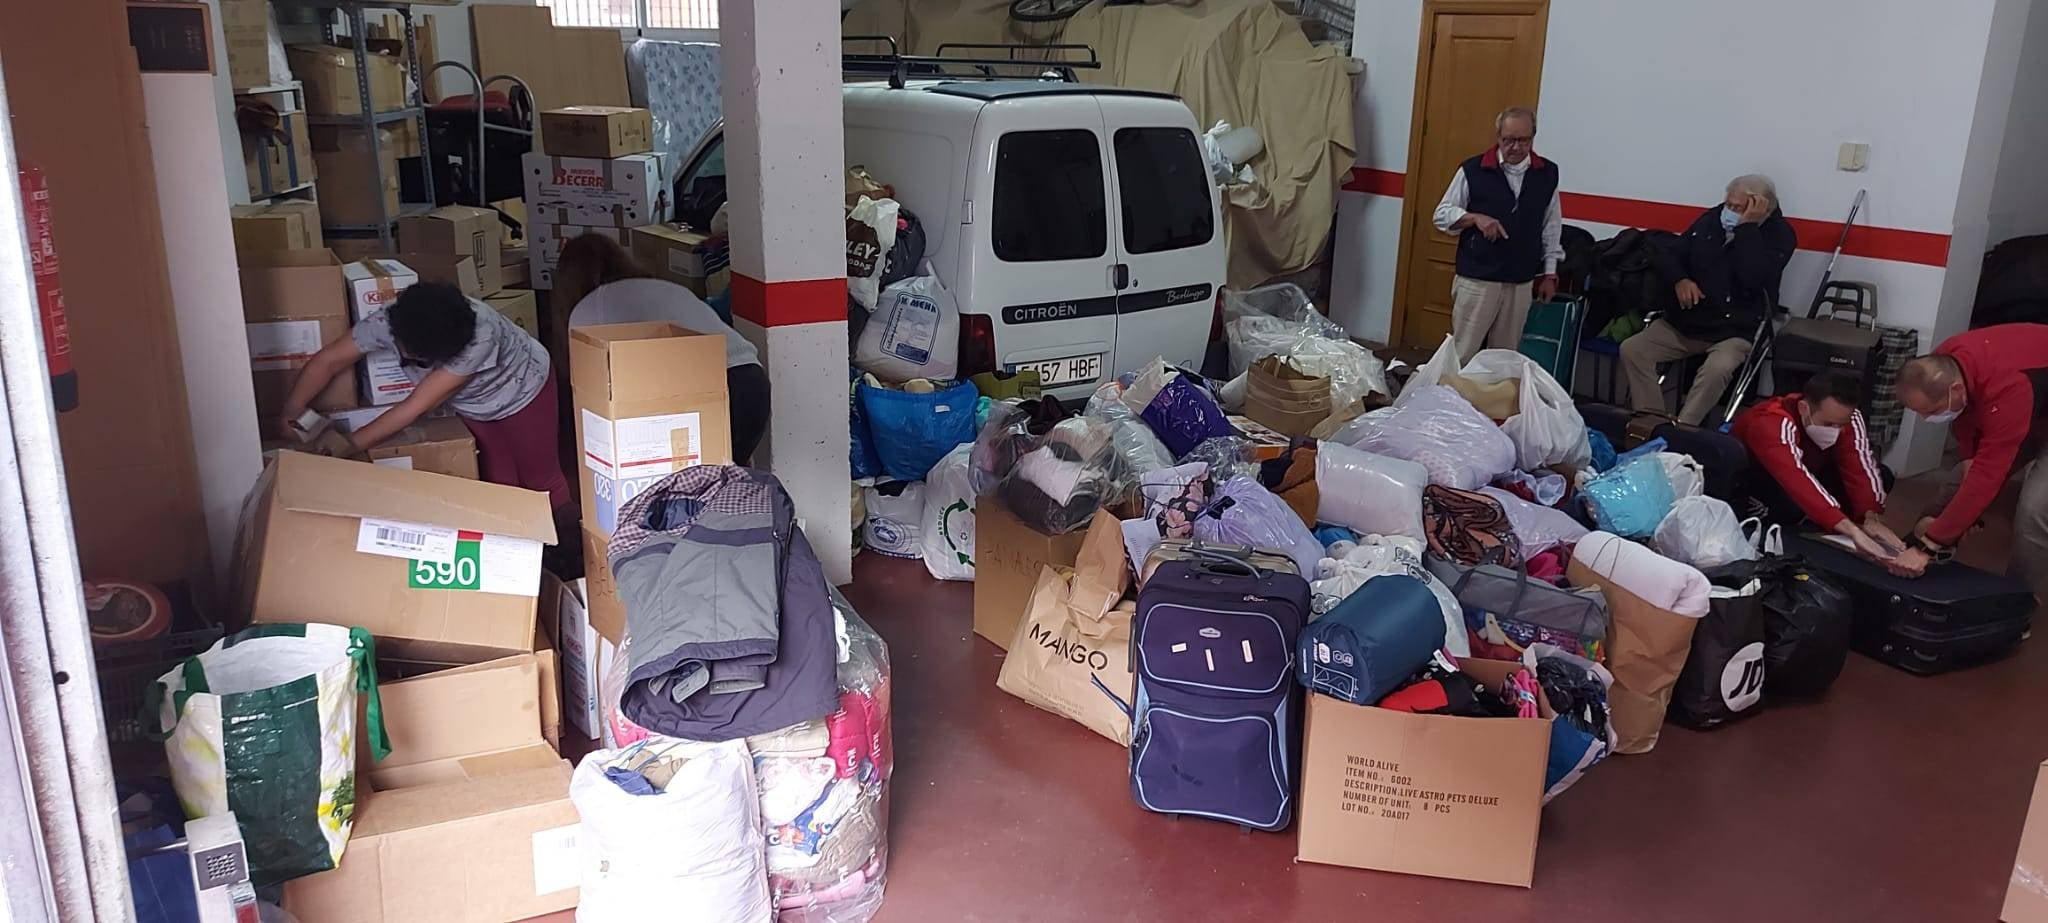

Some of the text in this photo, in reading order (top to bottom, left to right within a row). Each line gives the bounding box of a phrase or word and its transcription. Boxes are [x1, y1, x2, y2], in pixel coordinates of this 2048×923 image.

[552, 168, 605, 188] BECERR
[846, 241, 877, 260] LEY
[1166, 289, 1205, 303] Berlingo
[1014, 303, 1077, 321] CITROËN
[1069, 358, 1097, 379] HBF
[415, 556, 477, 586] 590
[1029, 623, 1108, 671] MANGO
[1728, 658, 1763, 700] JD
[1347, 755, 1400, 772] WORLD ALIVE
[1345, 767, 1364, 779] ITEM
[1391, 775, 1412, 787] 6002
[1343, 790, 1377, 804] NUMBER
[1379, 796, 1389, 806] OF
[1435, 805, 1451, 814] PCS
[1419, 790, 1445, 802] ASTRO
[1446, 793, 1467, 804] PETS
[1468, 795, 1499, 806] DELUXE
[1341, 801, 1356, 812] LOT
[1381, 808, 1410, 821] 20A017
